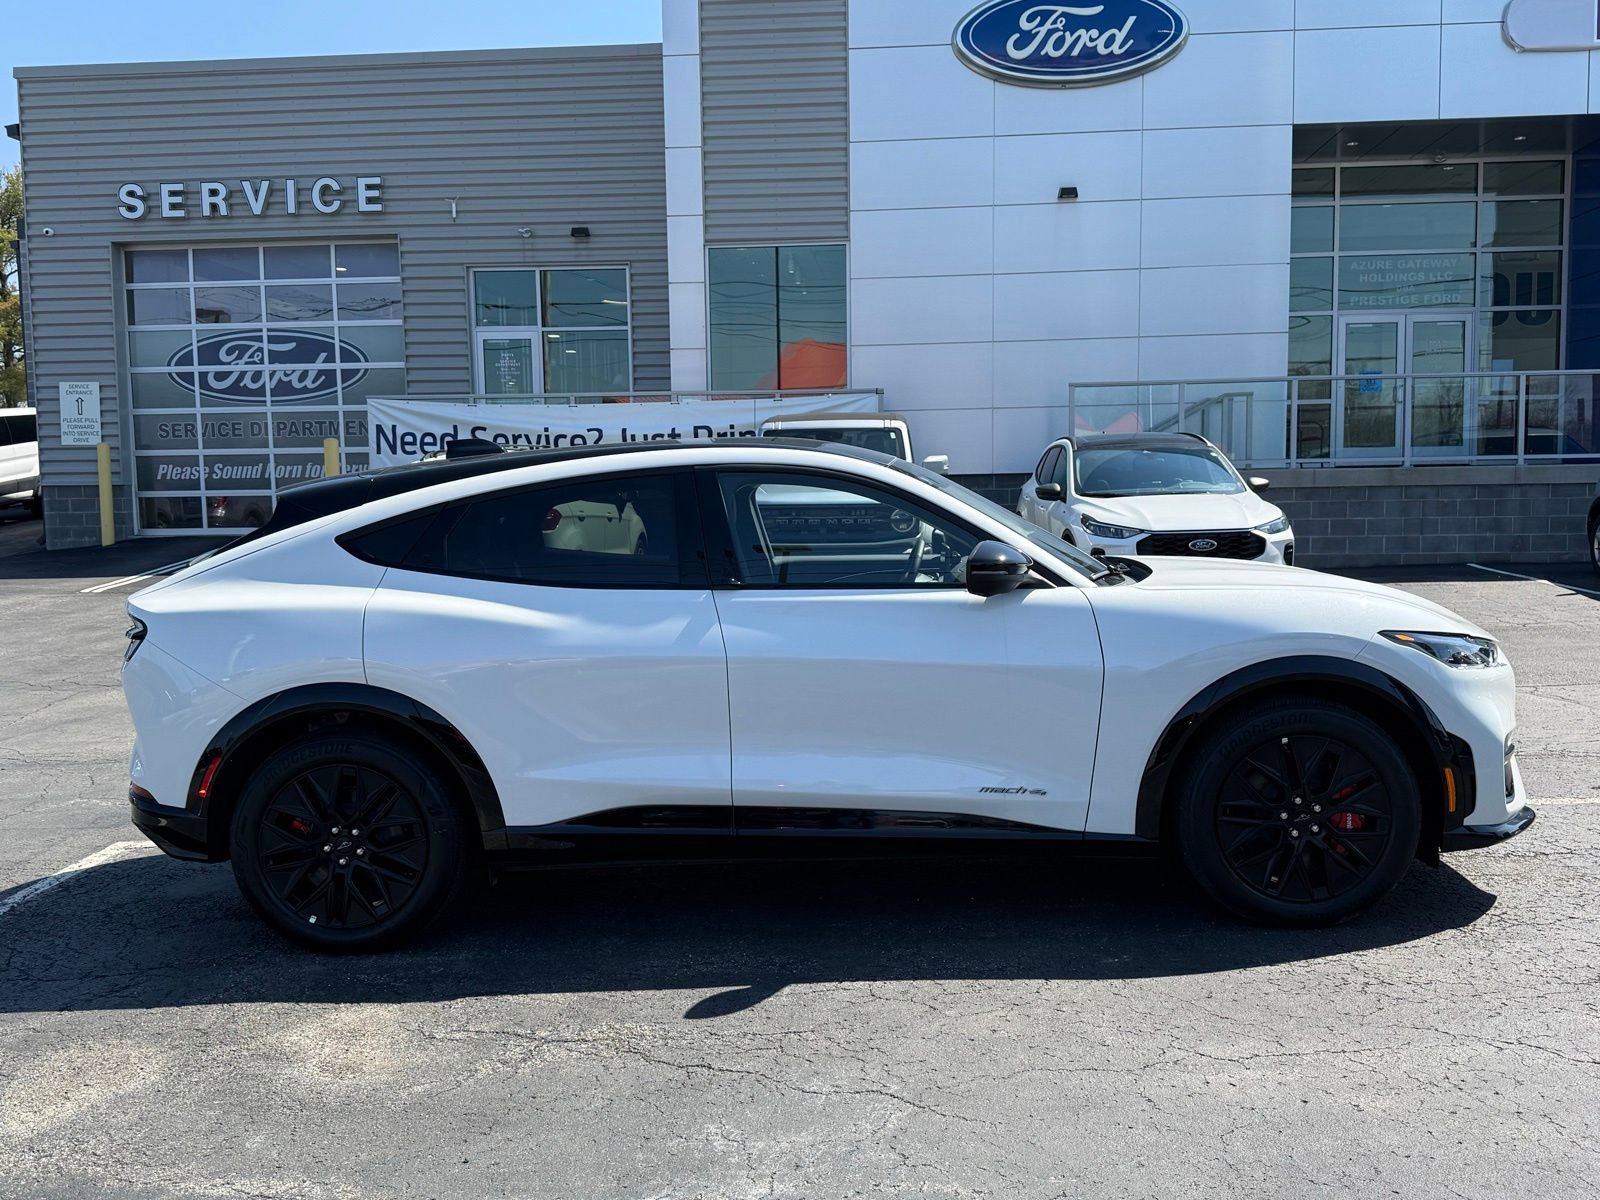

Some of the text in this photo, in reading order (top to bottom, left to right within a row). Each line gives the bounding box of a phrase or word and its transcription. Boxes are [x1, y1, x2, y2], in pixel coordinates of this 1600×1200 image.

[1006, 5, 1137, 59] Ford
[118, 176, 384, 220] SERVICE
[1350, 258, 1458, 271] AZURE GATEWAY
[1359, 270, 1454, 283] HOLDINGS LLC
[1350, 293, 1462, 307] PRESTIGE FORD
[207, 340, 328, 390] Ford
[158, 419, 369, 439] SERVICE DPARTMEN
[375, 424, 459, 456] Need
[157, 464, 209, 480] Please
[212, 463, 262, 479] Sound
